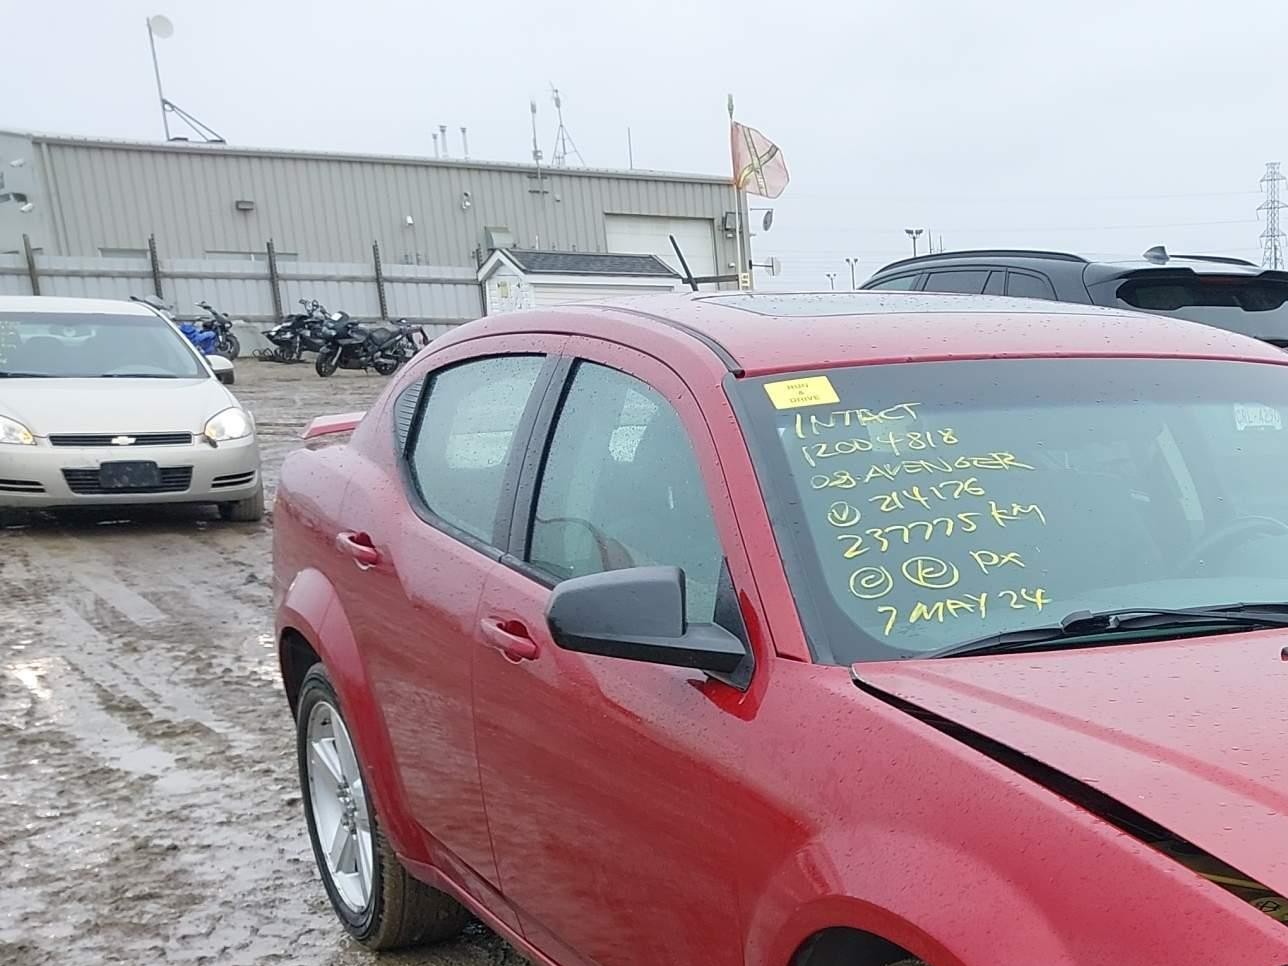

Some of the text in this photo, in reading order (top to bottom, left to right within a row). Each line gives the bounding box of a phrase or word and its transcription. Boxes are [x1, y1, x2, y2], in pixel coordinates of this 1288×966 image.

[795, 402, 921, 438] INTACT
[868, 478, 985, 512] 214176
[837, 512, 983, 558] 237775
[877, 588, 1053, 636] 7 MAY 24
